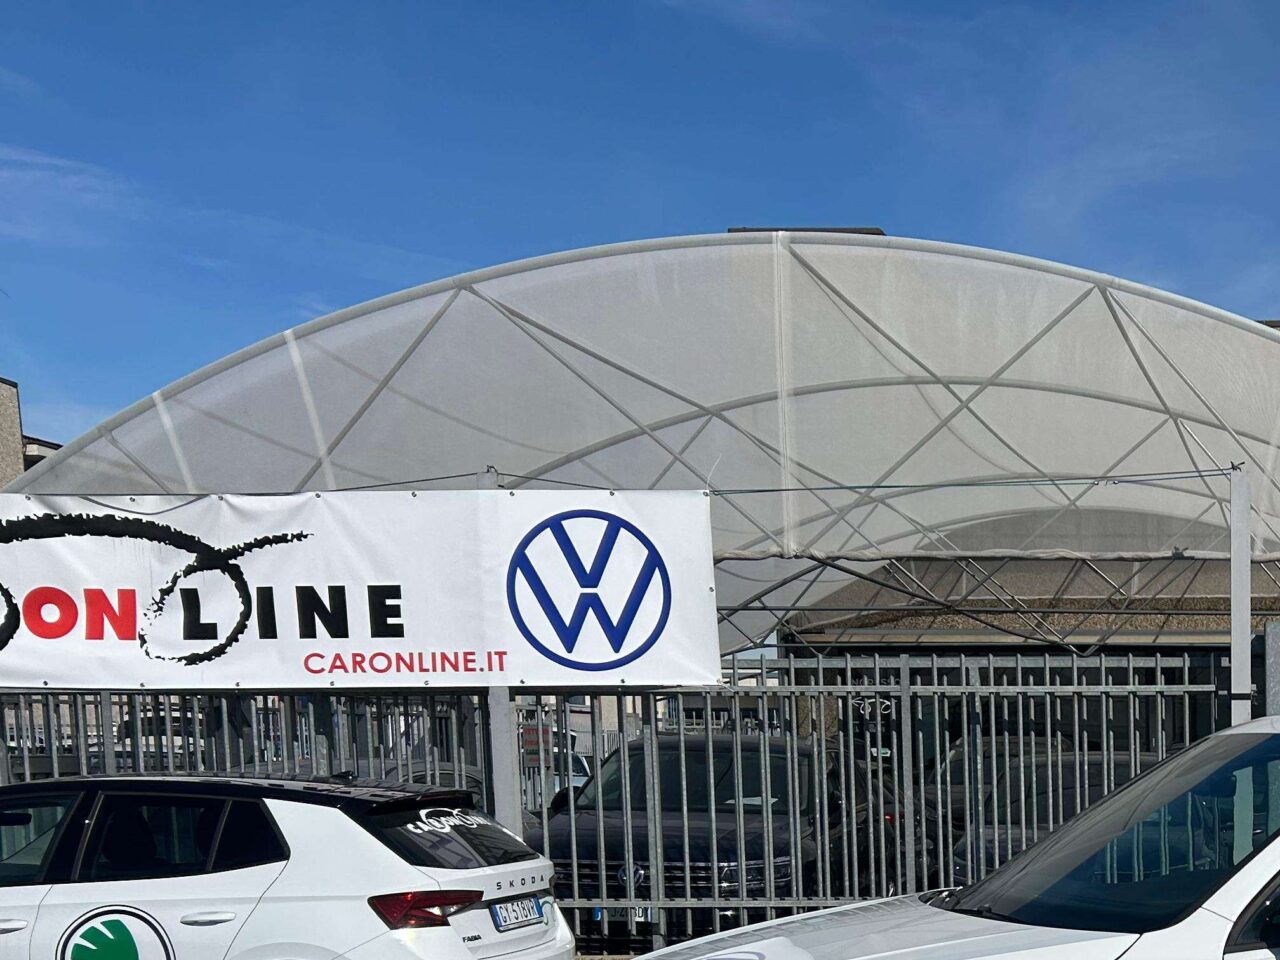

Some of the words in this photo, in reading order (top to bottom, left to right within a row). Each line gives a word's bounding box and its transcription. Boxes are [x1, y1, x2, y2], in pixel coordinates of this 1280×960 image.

[22, 586, 137, 641] ON
[179, 584, 405, 641] LINE
[303, 651, 508, 674] CARONLINE.IT
